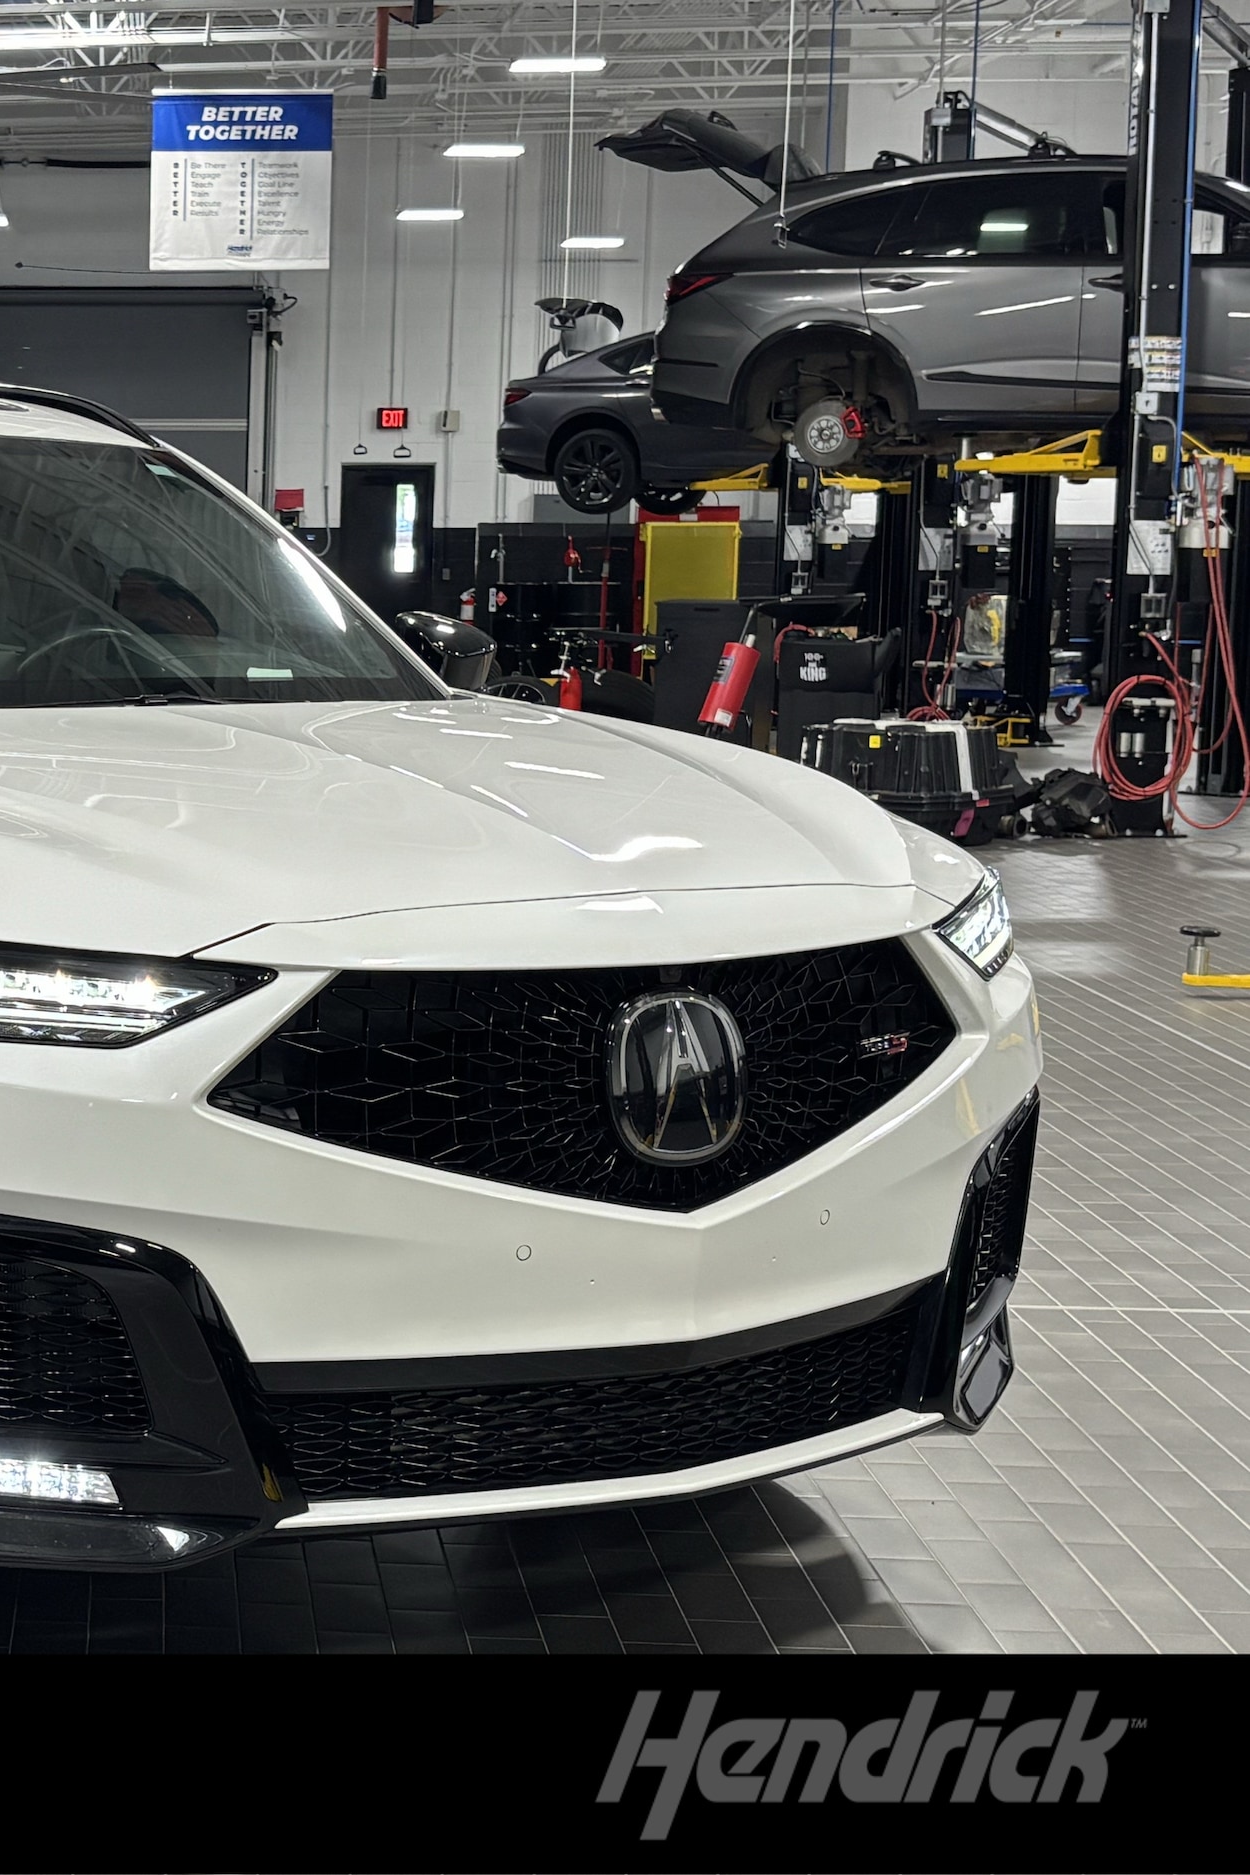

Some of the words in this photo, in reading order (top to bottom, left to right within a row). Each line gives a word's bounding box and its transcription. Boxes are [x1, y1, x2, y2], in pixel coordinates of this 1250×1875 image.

[201, 106, 283, 122] BETTER
[186, 124, 299, 141] TOGETHER
[190, 171, 221, 179] Engage
[381, 409, 405, 427] EXIT
[799, 666, 827, 682] KING
